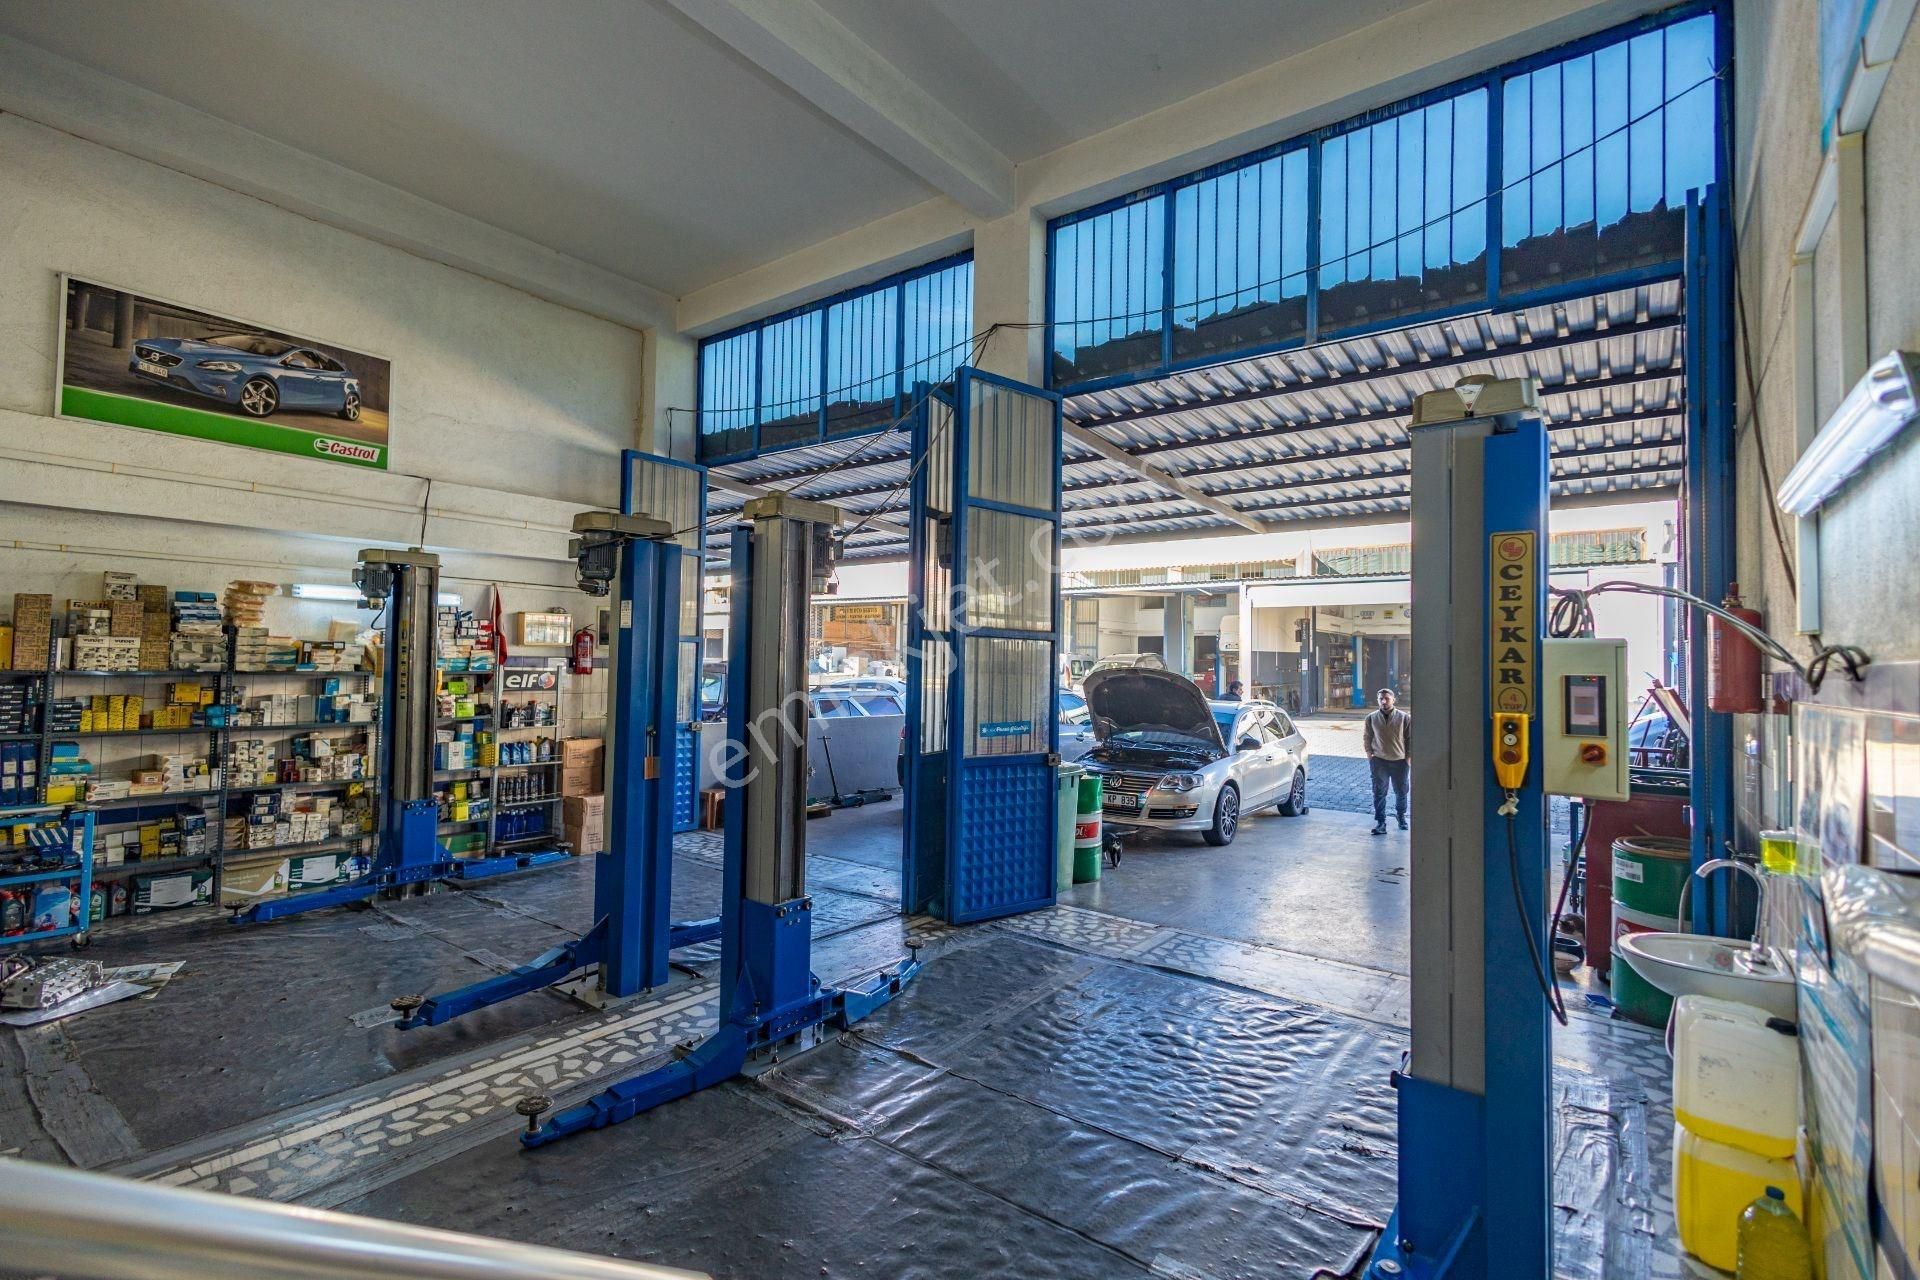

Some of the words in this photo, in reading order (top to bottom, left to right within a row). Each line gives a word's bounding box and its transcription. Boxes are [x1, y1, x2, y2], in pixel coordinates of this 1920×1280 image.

[330, 442, 377, 460] Castrol
[1498, 564, 1527, 684] CEYKAR
[506, 673, 538, 688] elf
[1107, 795, 1117, 804] KP
[1120, 796, 1135, 806] 835
